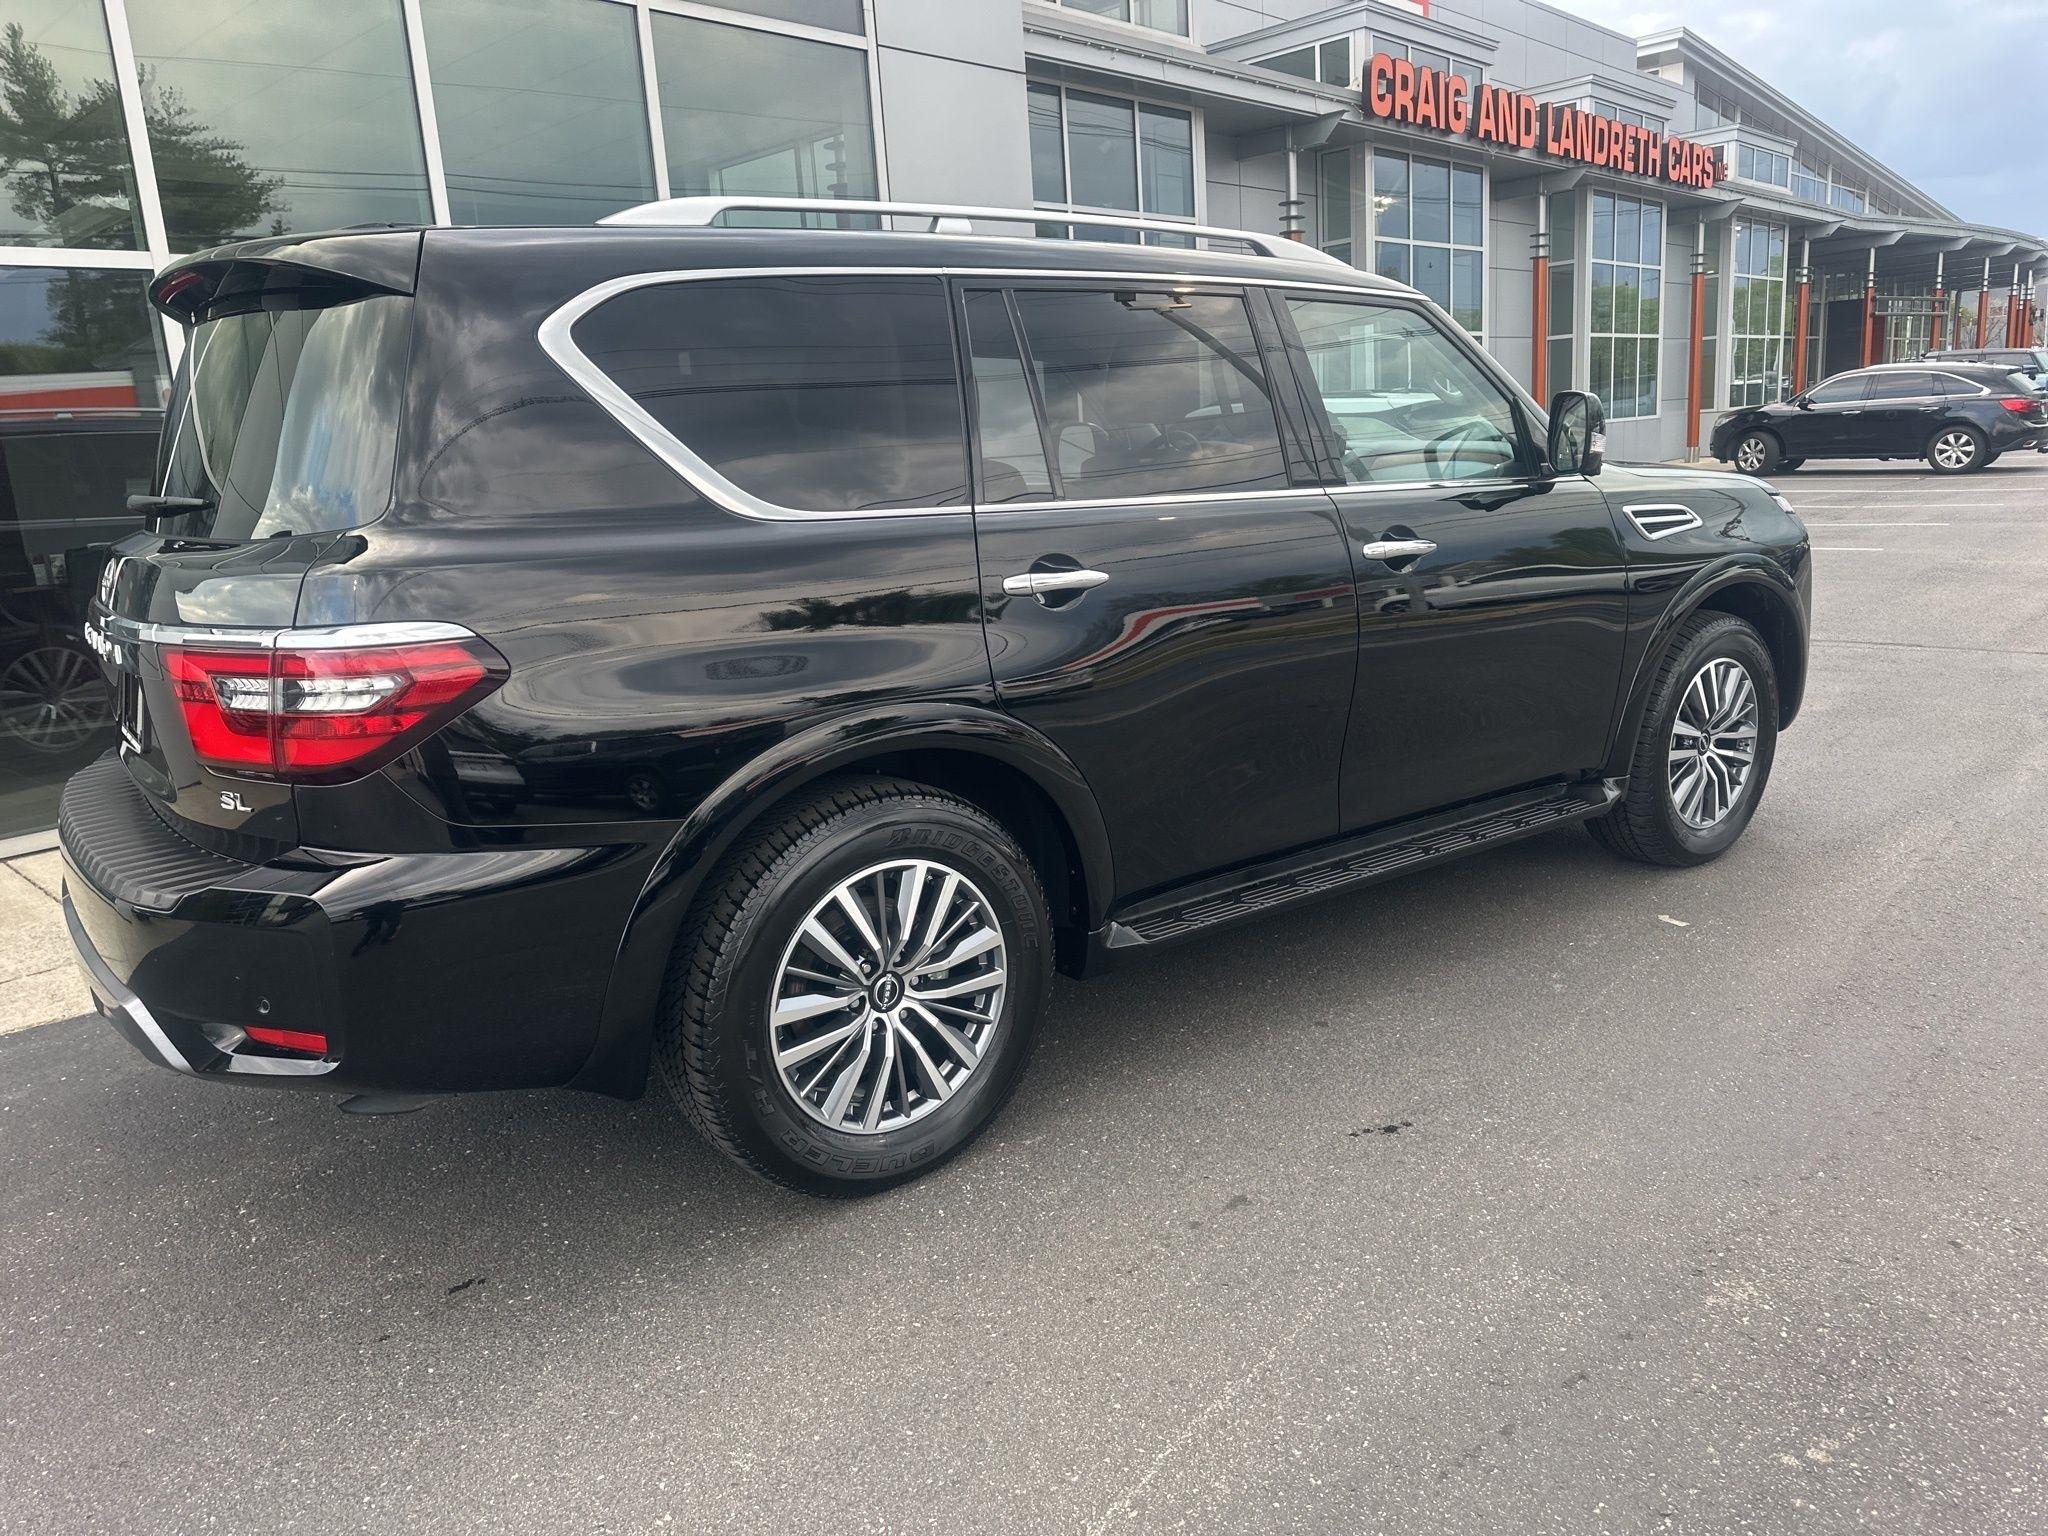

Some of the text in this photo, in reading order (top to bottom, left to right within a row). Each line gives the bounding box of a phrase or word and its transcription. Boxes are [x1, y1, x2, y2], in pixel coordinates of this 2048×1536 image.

[1368, 53, 1467, 134] CRAIG
[1477, 84, 1536, 149] AND
[1545, 102, 1661, 177] LANDRETH
[1667, 136, 1714, 189] CARS
[220, 791, 252, 812] SL
